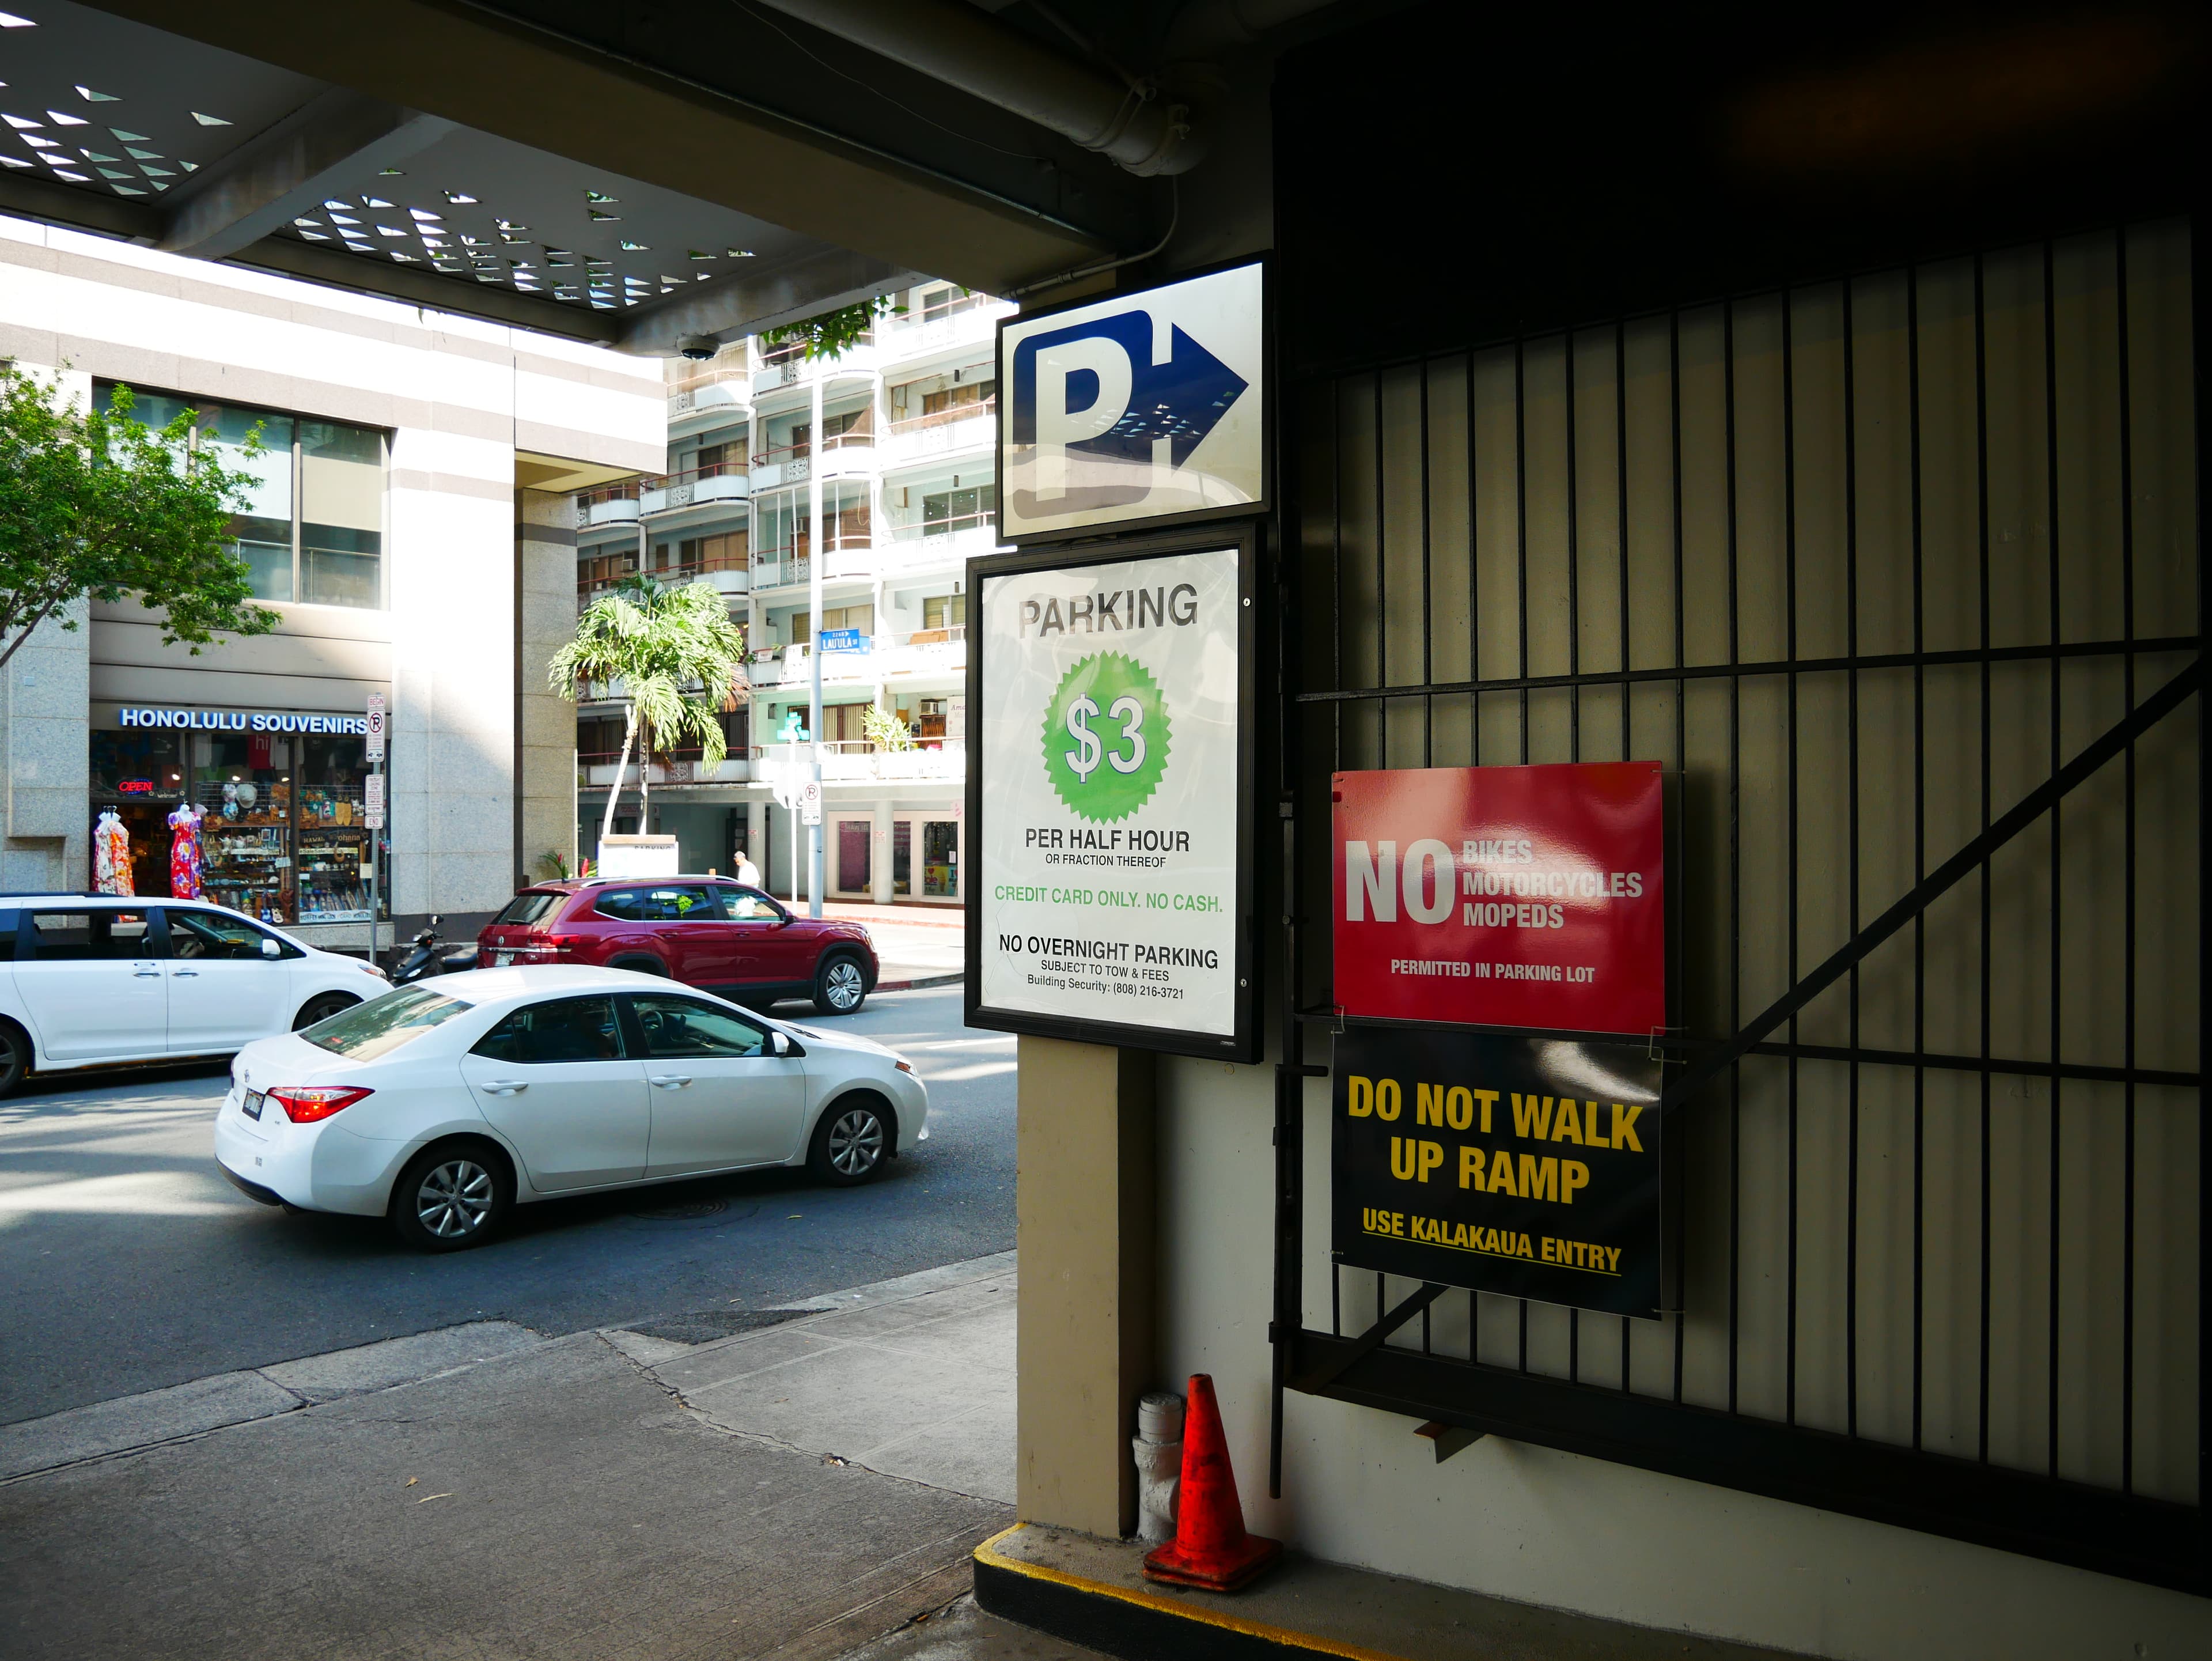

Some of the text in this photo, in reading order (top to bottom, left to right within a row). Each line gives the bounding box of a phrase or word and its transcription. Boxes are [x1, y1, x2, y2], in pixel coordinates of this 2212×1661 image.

[1036, 336, 1132, 502] P
[1018, 583, 1198, 640] PARKING
[120, 708, 368, 735] HONOLULU SOUVENIRS
[256, 735, 269, 750] hi
[1064, 692, 1147, 784] $3
[119, 781, 154, 792] OPEN
[369, 818, 378, 826] END
[1025, 828, 1190, 852] PER HALF HOUR
[1463, 840, 1533, 864] BIKES
[1046, 854, 1166, 868] OR FRACTION THEREOF
[1345, 839, 1456, 925] NO
[1463, 872, 1643, 898] MOTORCYCLES
[995, 886, 1223, 912] CREDIT CARD ONLY. NO CASH.
[1463, 903, 1564, 929] MOPEDS
[999, 934, 1218, 969] NO OVERNIGHT PARKING
[1040, 959, 1170, 982] SUBJECT TO TOW & FEES
[1391, 959, 1595, 983] PERMITTED IN PARKING LOT
[1027, 974, 1184, 1000] Building Security: (808) 216-3721
[1348, 1075, 1644, 1153] DO NOT WALK
[1391, 1137, 1590, 1204] UP RAMP
[1362, 1208, 1622, 1272] USE KALAKAUA ENTRY
